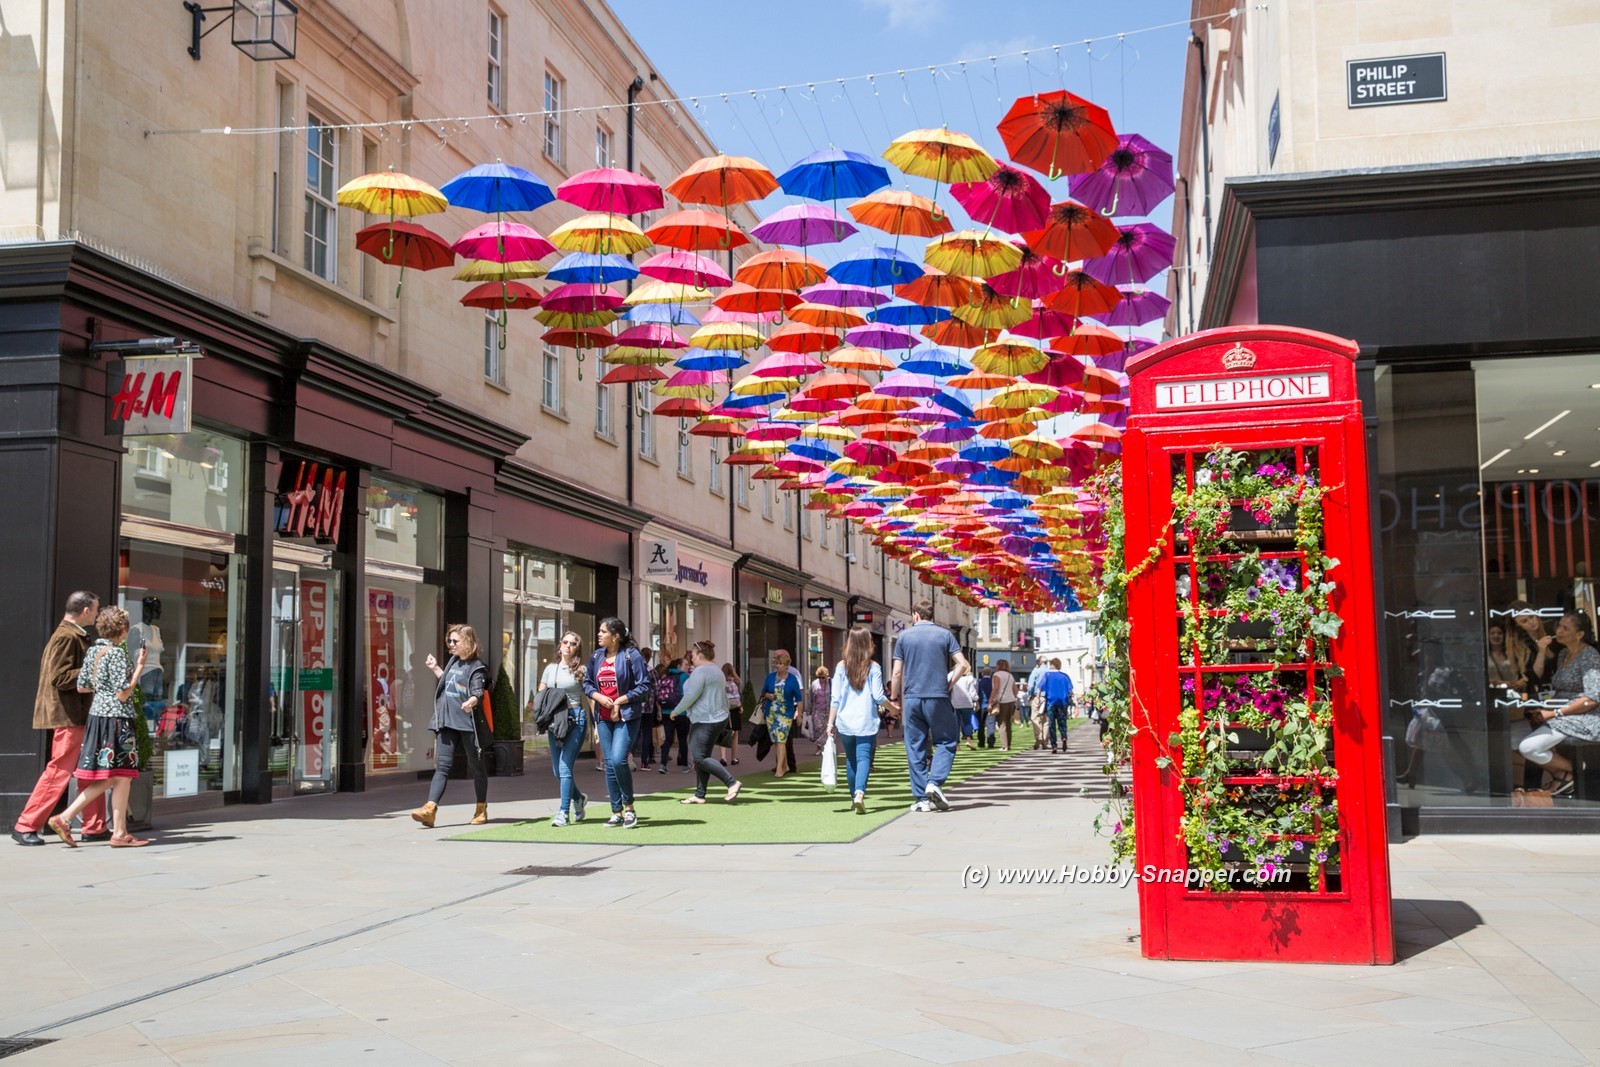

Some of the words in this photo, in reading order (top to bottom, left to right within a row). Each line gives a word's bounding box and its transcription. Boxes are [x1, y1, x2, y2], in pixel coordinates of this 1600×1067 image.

[1356, 65, 1408, 82] PHILIP
[1356, 80, 1416, 99] STREET
[111, 370, 182, 421] H&M
[1163, 375, 1322, 405] TELEPHONE
[286, 460, 347, 545] H&M
[650, 543, 669, 565] A
[309, 586, 324, 631] UP
[375, 594, 388, 636] UP
